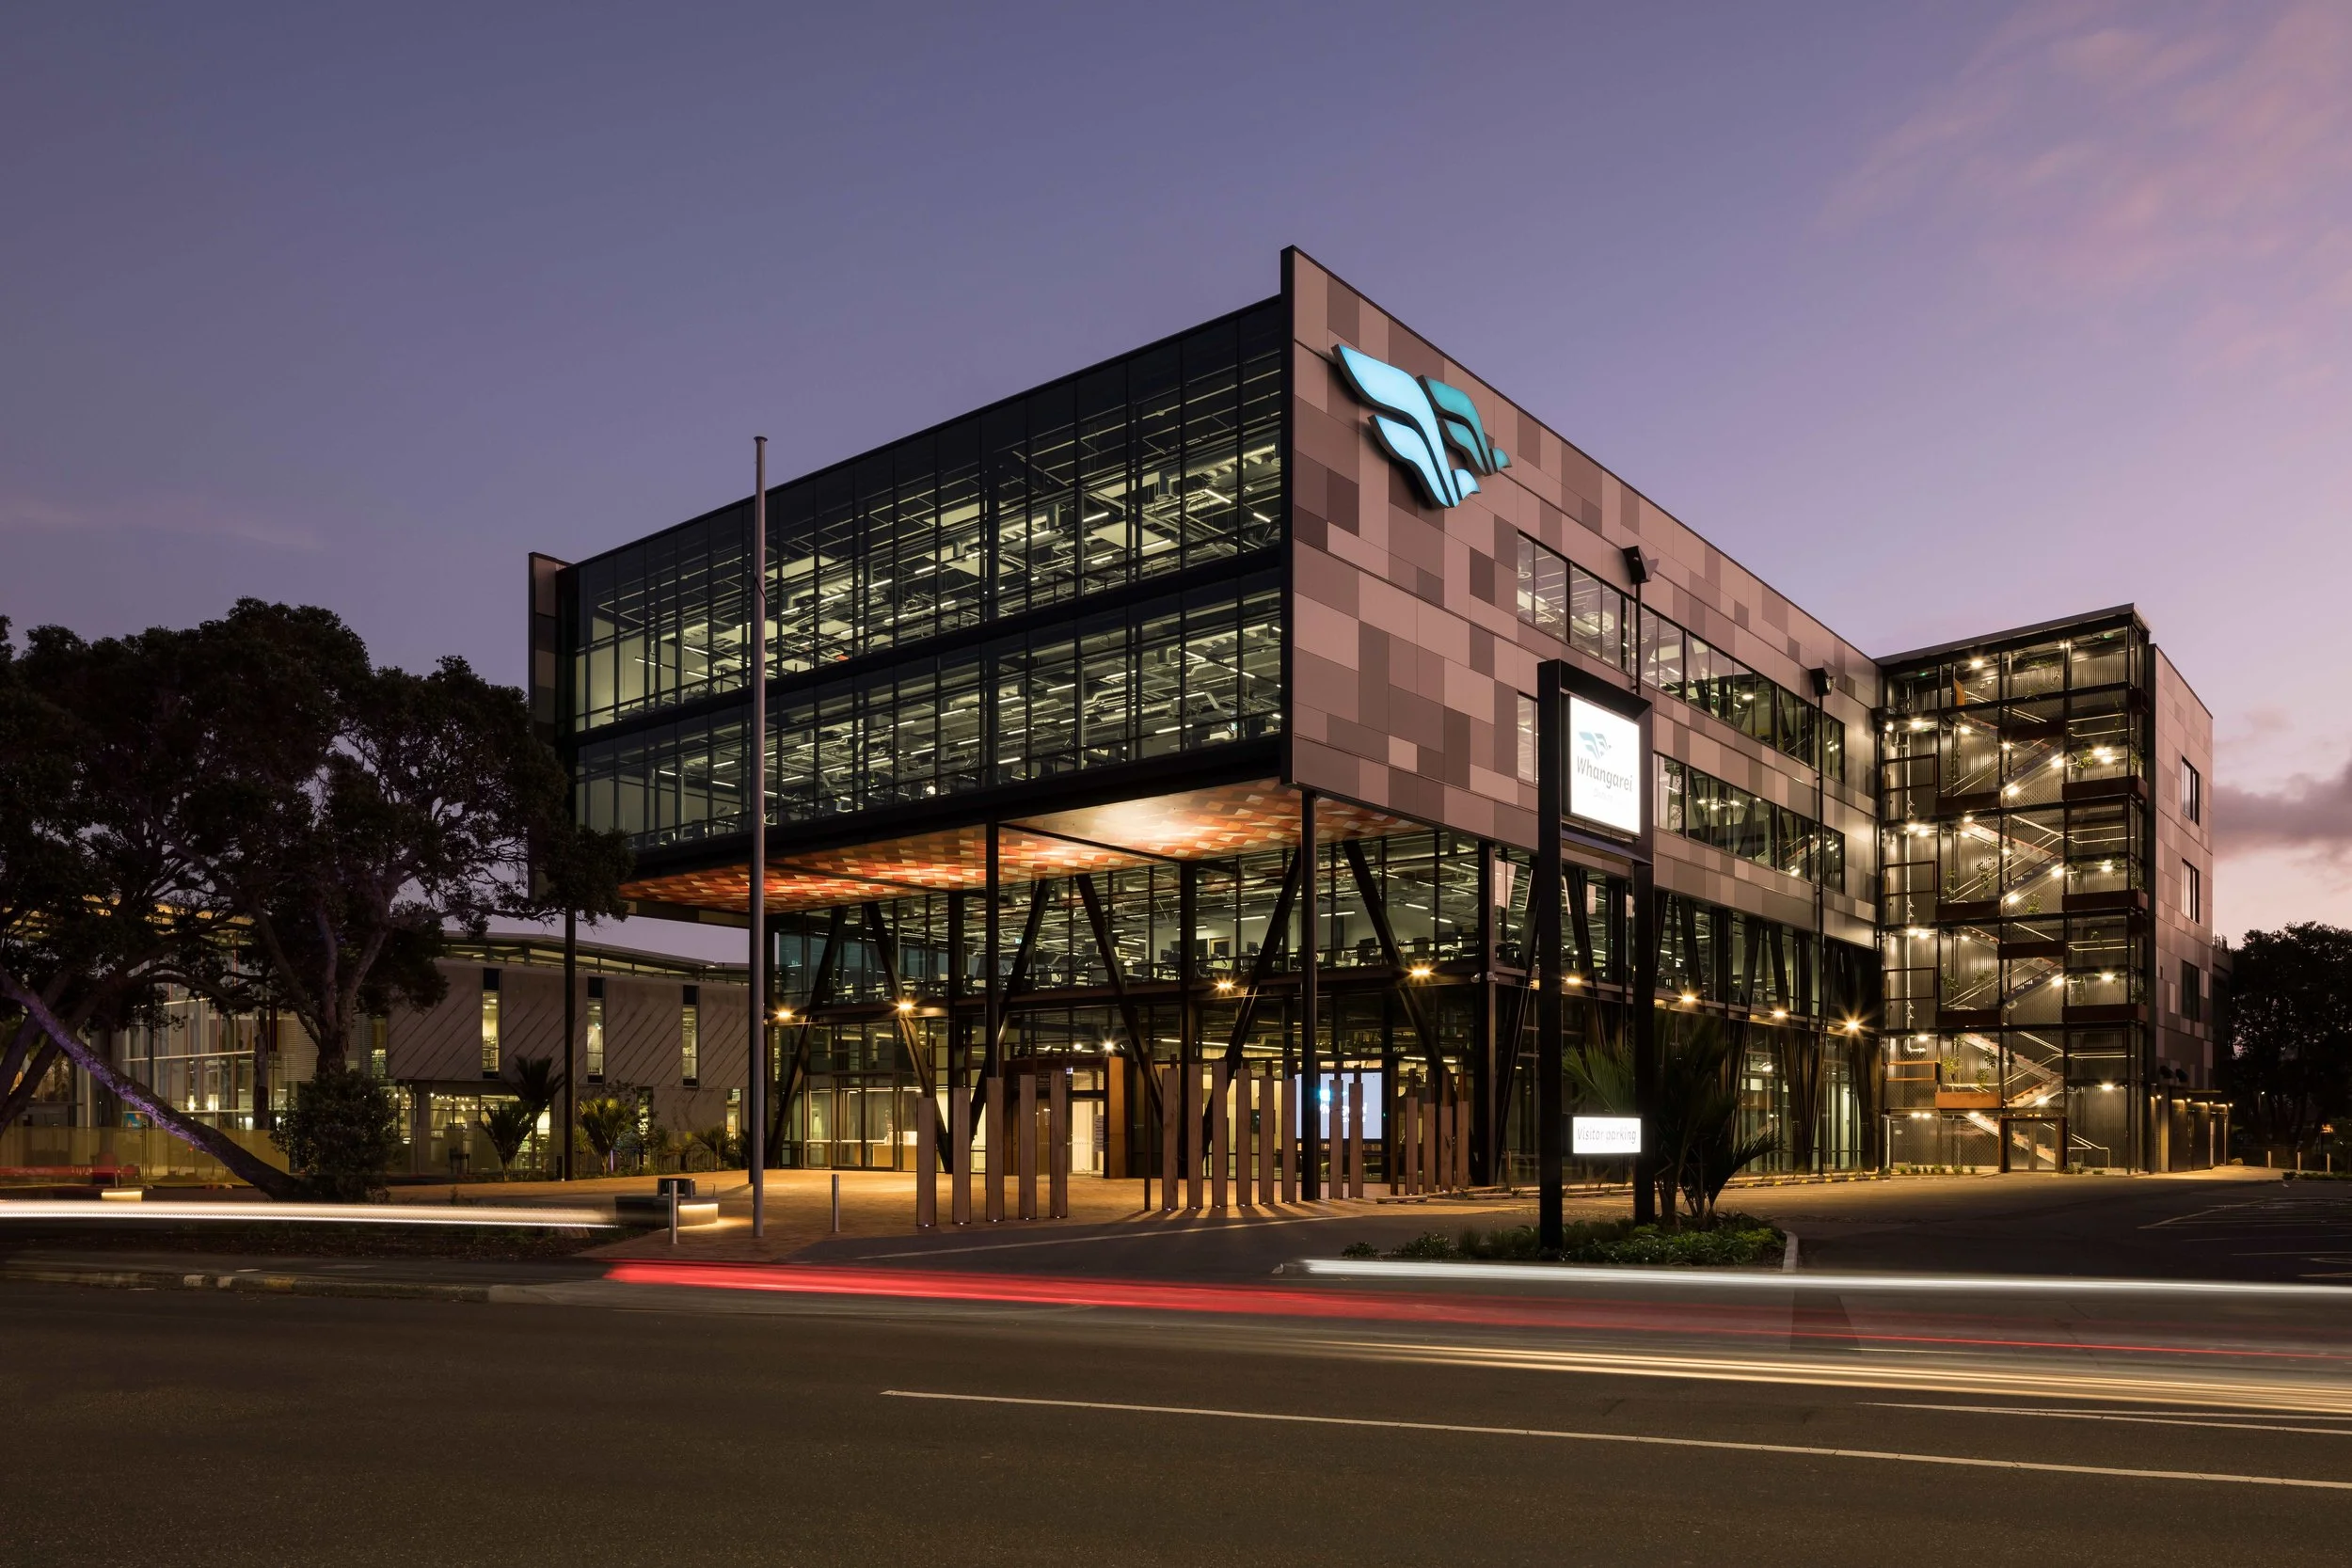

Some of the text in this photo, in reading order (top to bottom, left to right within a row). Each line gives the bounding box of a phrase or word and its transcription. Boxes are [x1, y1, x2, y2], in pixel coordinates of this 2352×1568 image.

[1577, 755, 1632, 792] Whangarei
[1577, 1126, 1637, 1145] Visitor parking
